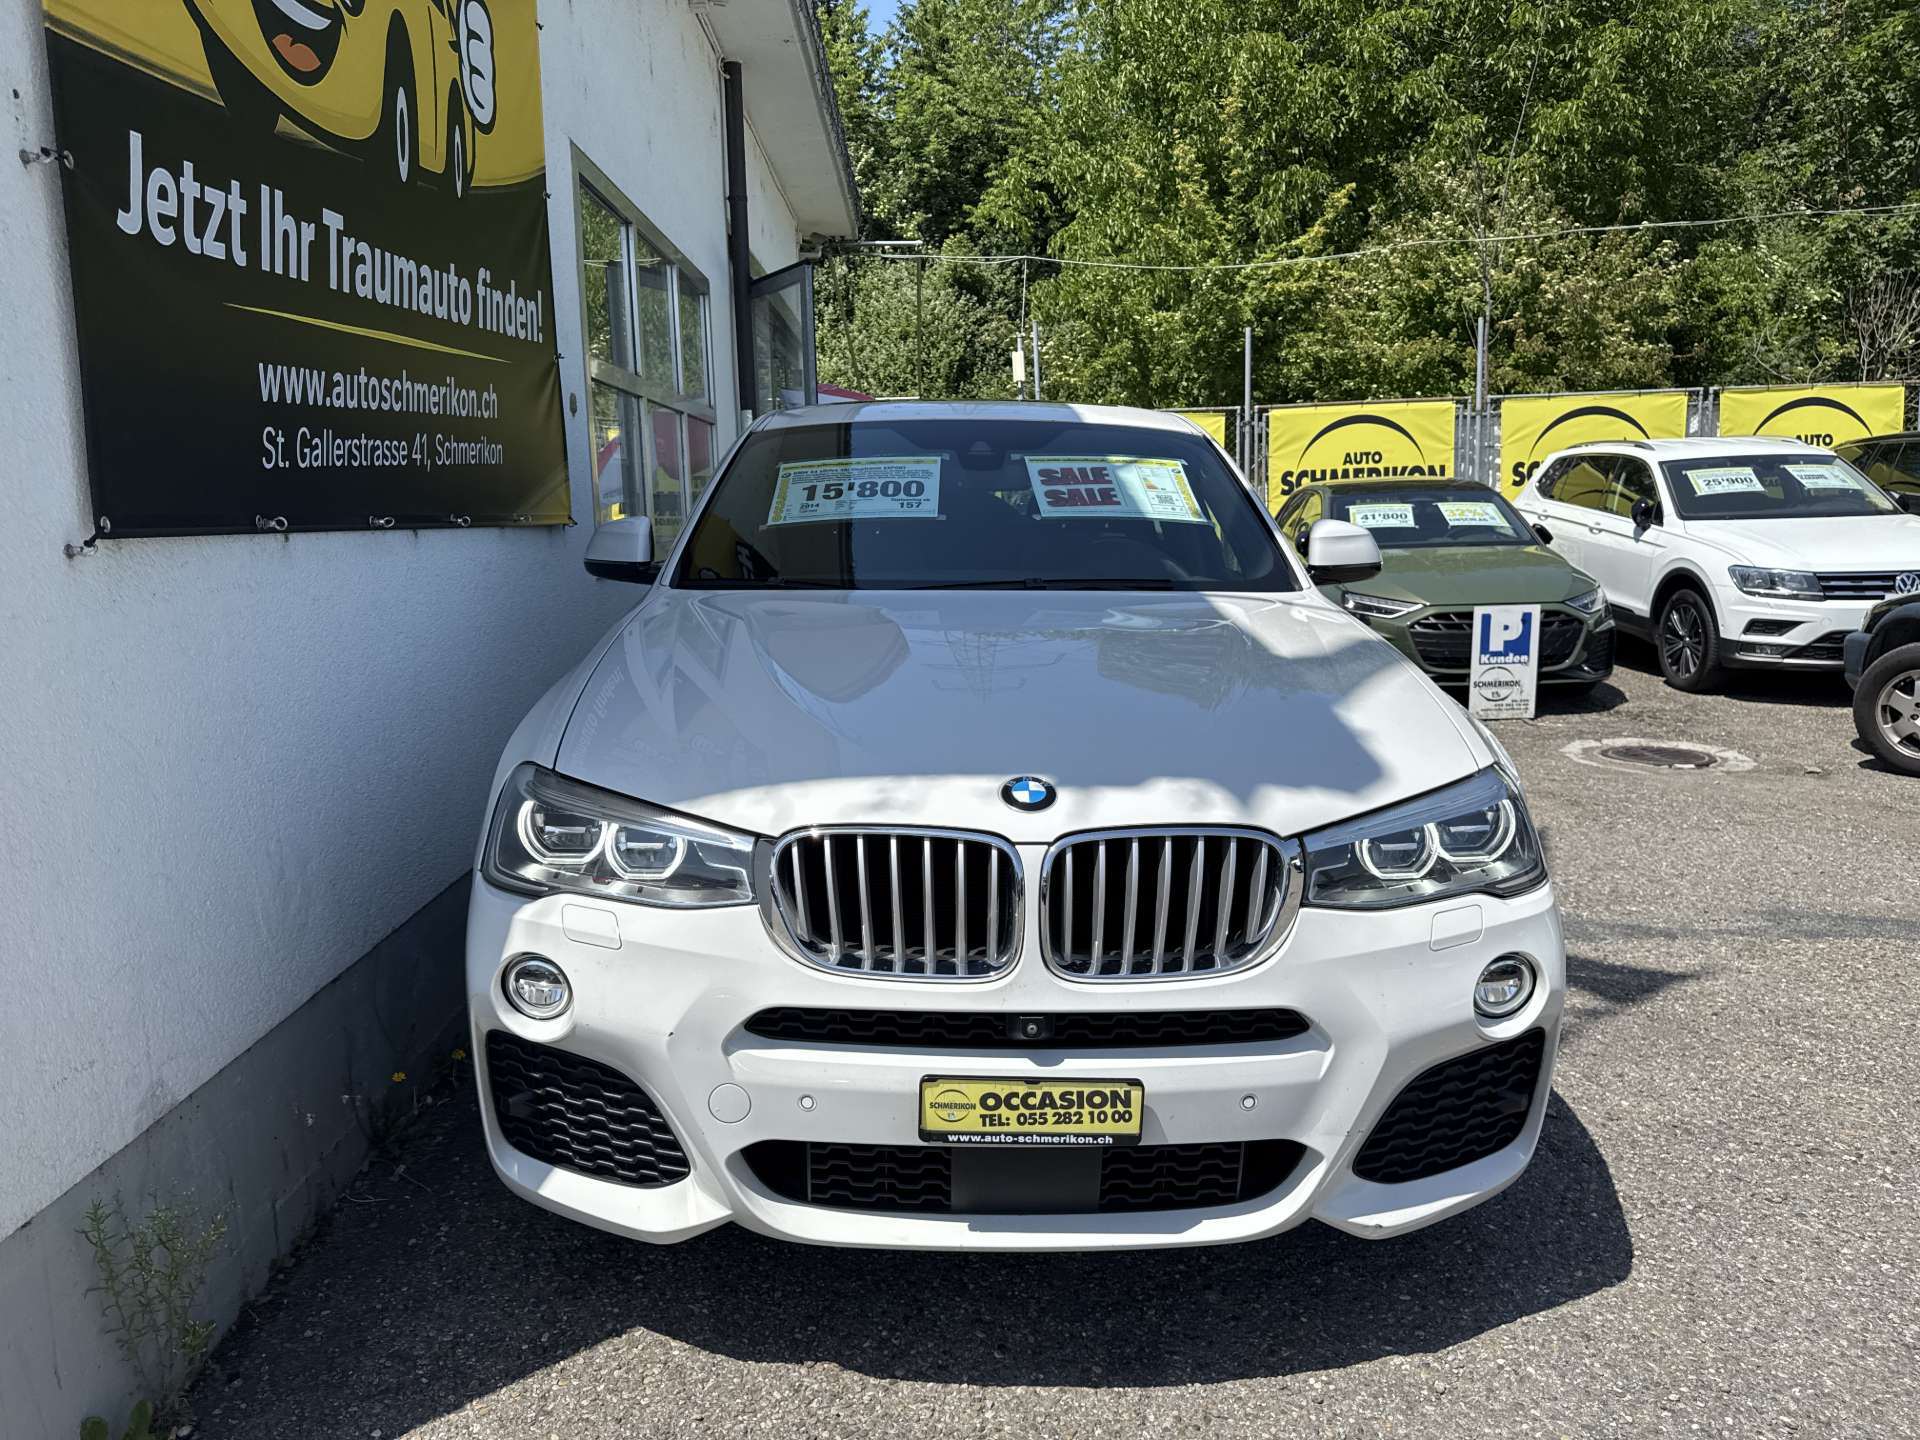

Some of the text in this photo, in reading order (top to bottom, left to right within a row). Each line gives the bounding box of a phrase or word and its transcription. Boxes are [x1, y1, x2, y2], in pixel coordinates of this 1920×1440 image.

[117, 130, 543, 343] Jetzt Ihr Traumauto finden!
[258, 362, 498, 418] www.autoschmerikon.ch
[262, 426, 503, 472] St. Gallerstrasse 41, Schmerikon
[1342, 451, 1382, 465] AUTO
[1038, 466, 1113, 486] SALE
[1702, 476, 1753, 487] 25'900
[801, 480, 925, 502] 15'800
[1044, 487, 1122, 507] SALE
[899, 501, 922, 509] 157
[1360, 512, 1408, 521] 41'800
[1480, 653, 1529, 664] Kunden
[1473, 680, 1521, 688] SCHMERIKON
[929, 1102, 976, 1110] SCHMERIKON
[979, 1090, 1133, 1111] OCCASION
[980, 1109, 1133, 1127] TEL: 055 282 10 00
[947, 1133, 1113, 1145] www.auto-schmerikon.ch
